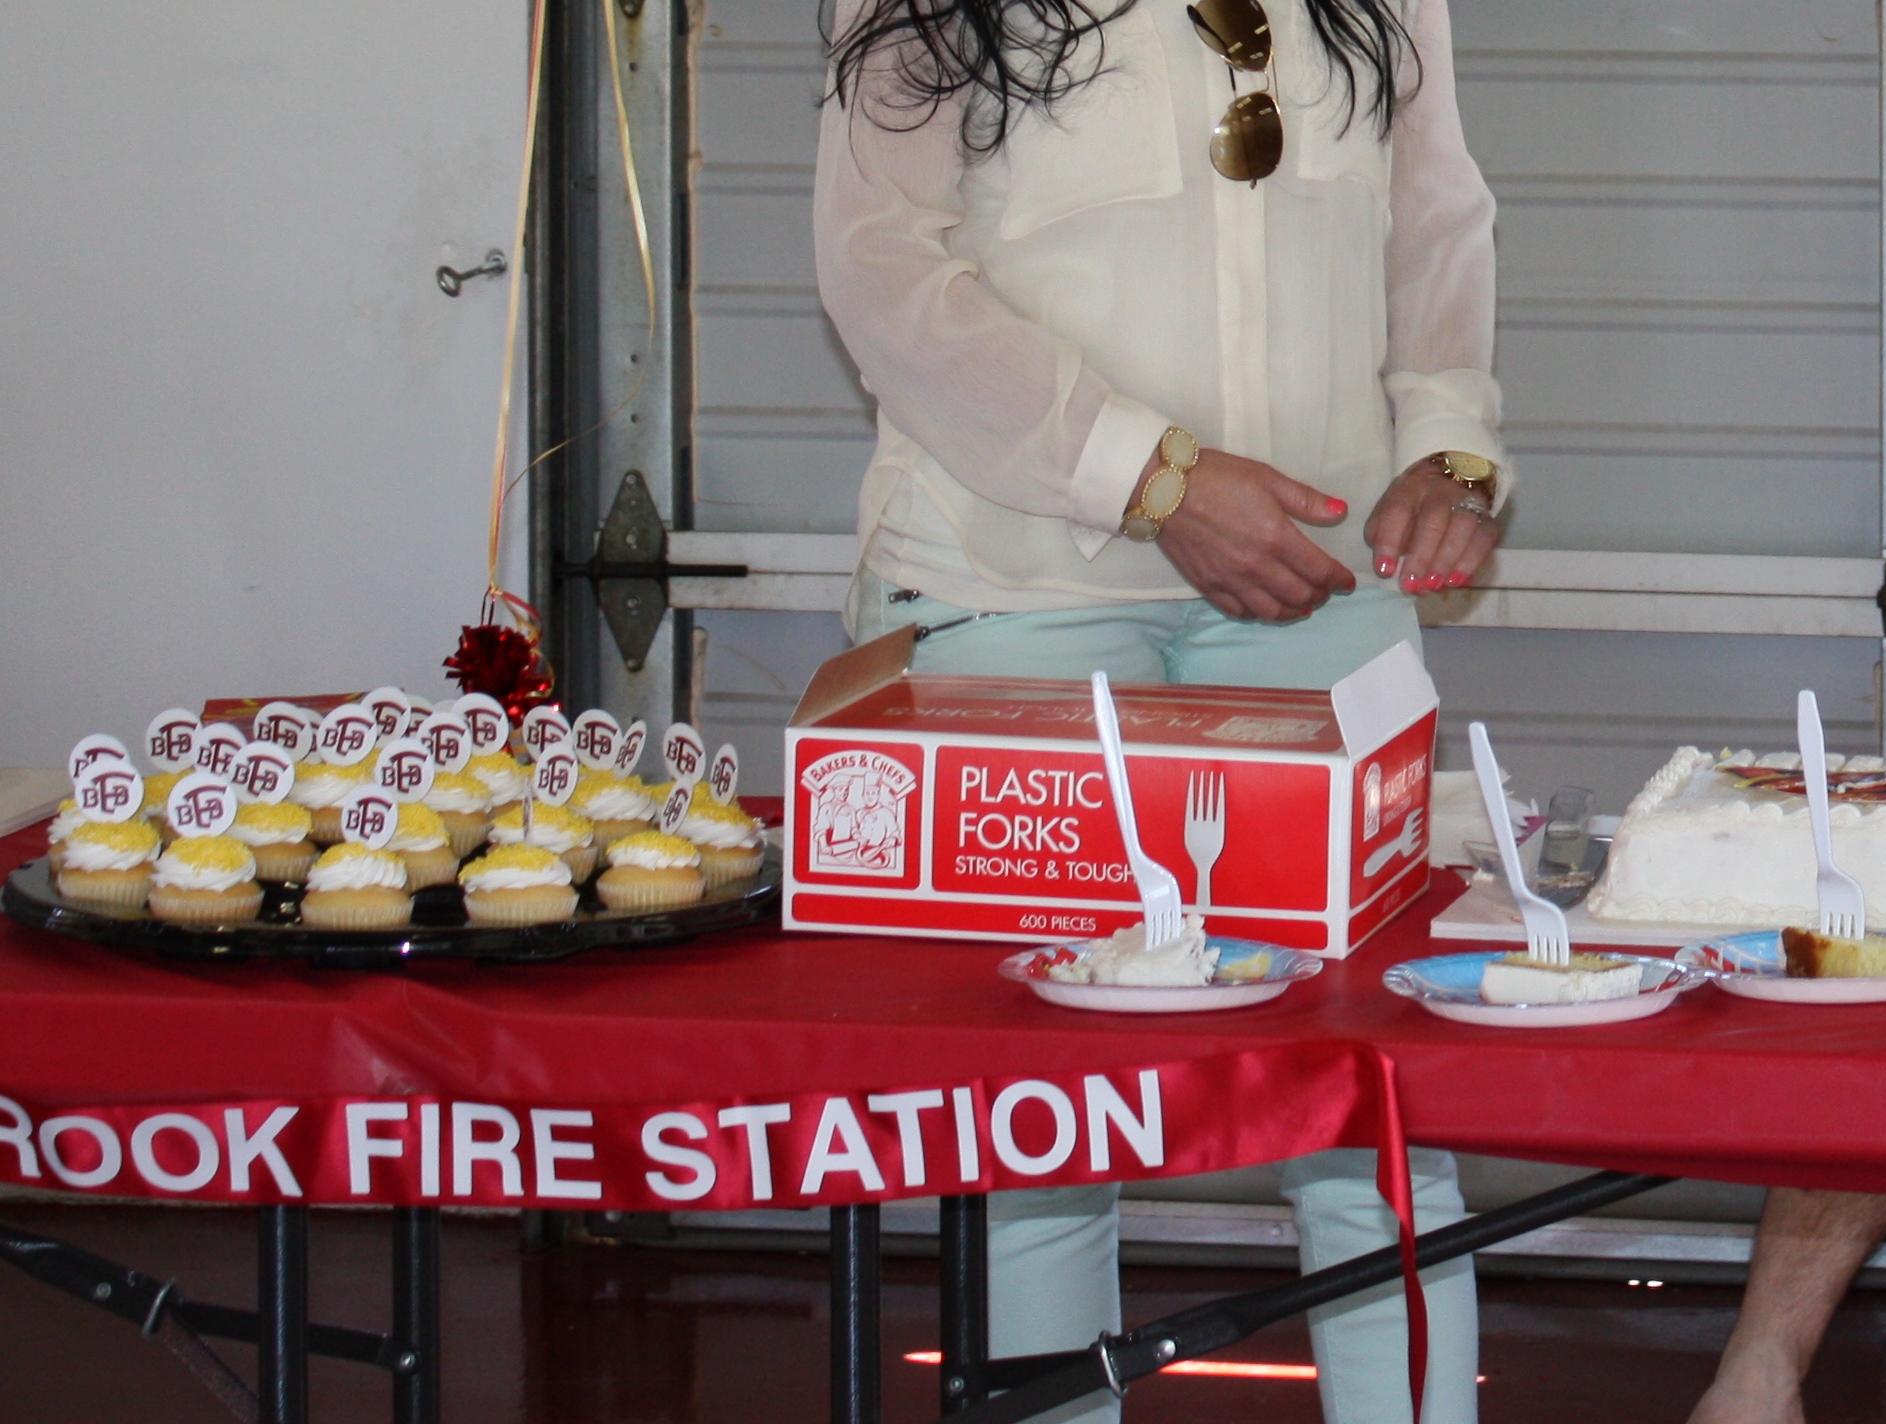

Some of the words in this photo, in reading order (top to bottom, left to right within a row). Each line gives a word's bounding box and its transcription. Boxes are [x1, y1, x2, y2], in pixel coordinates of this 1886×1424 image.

[810, 756, 855, 782] BAKERS
[860, 754, 867, 767] &
[959, 766, 1104, 809] PLASTIC
[957, 812, 1081, 854] FORKS
[955, 856, 1038, 879] STRONG
[1045, 860, 1060, 880] &
[1067, 861, 1137, 884] TOUGH
[1019, 914, 1046, 930] 600
[1051, 916, 1097, 932] PIECES
[345, 1101, 602, 1199] FIRE
[641, 1069, 1164, 1201] STATION
